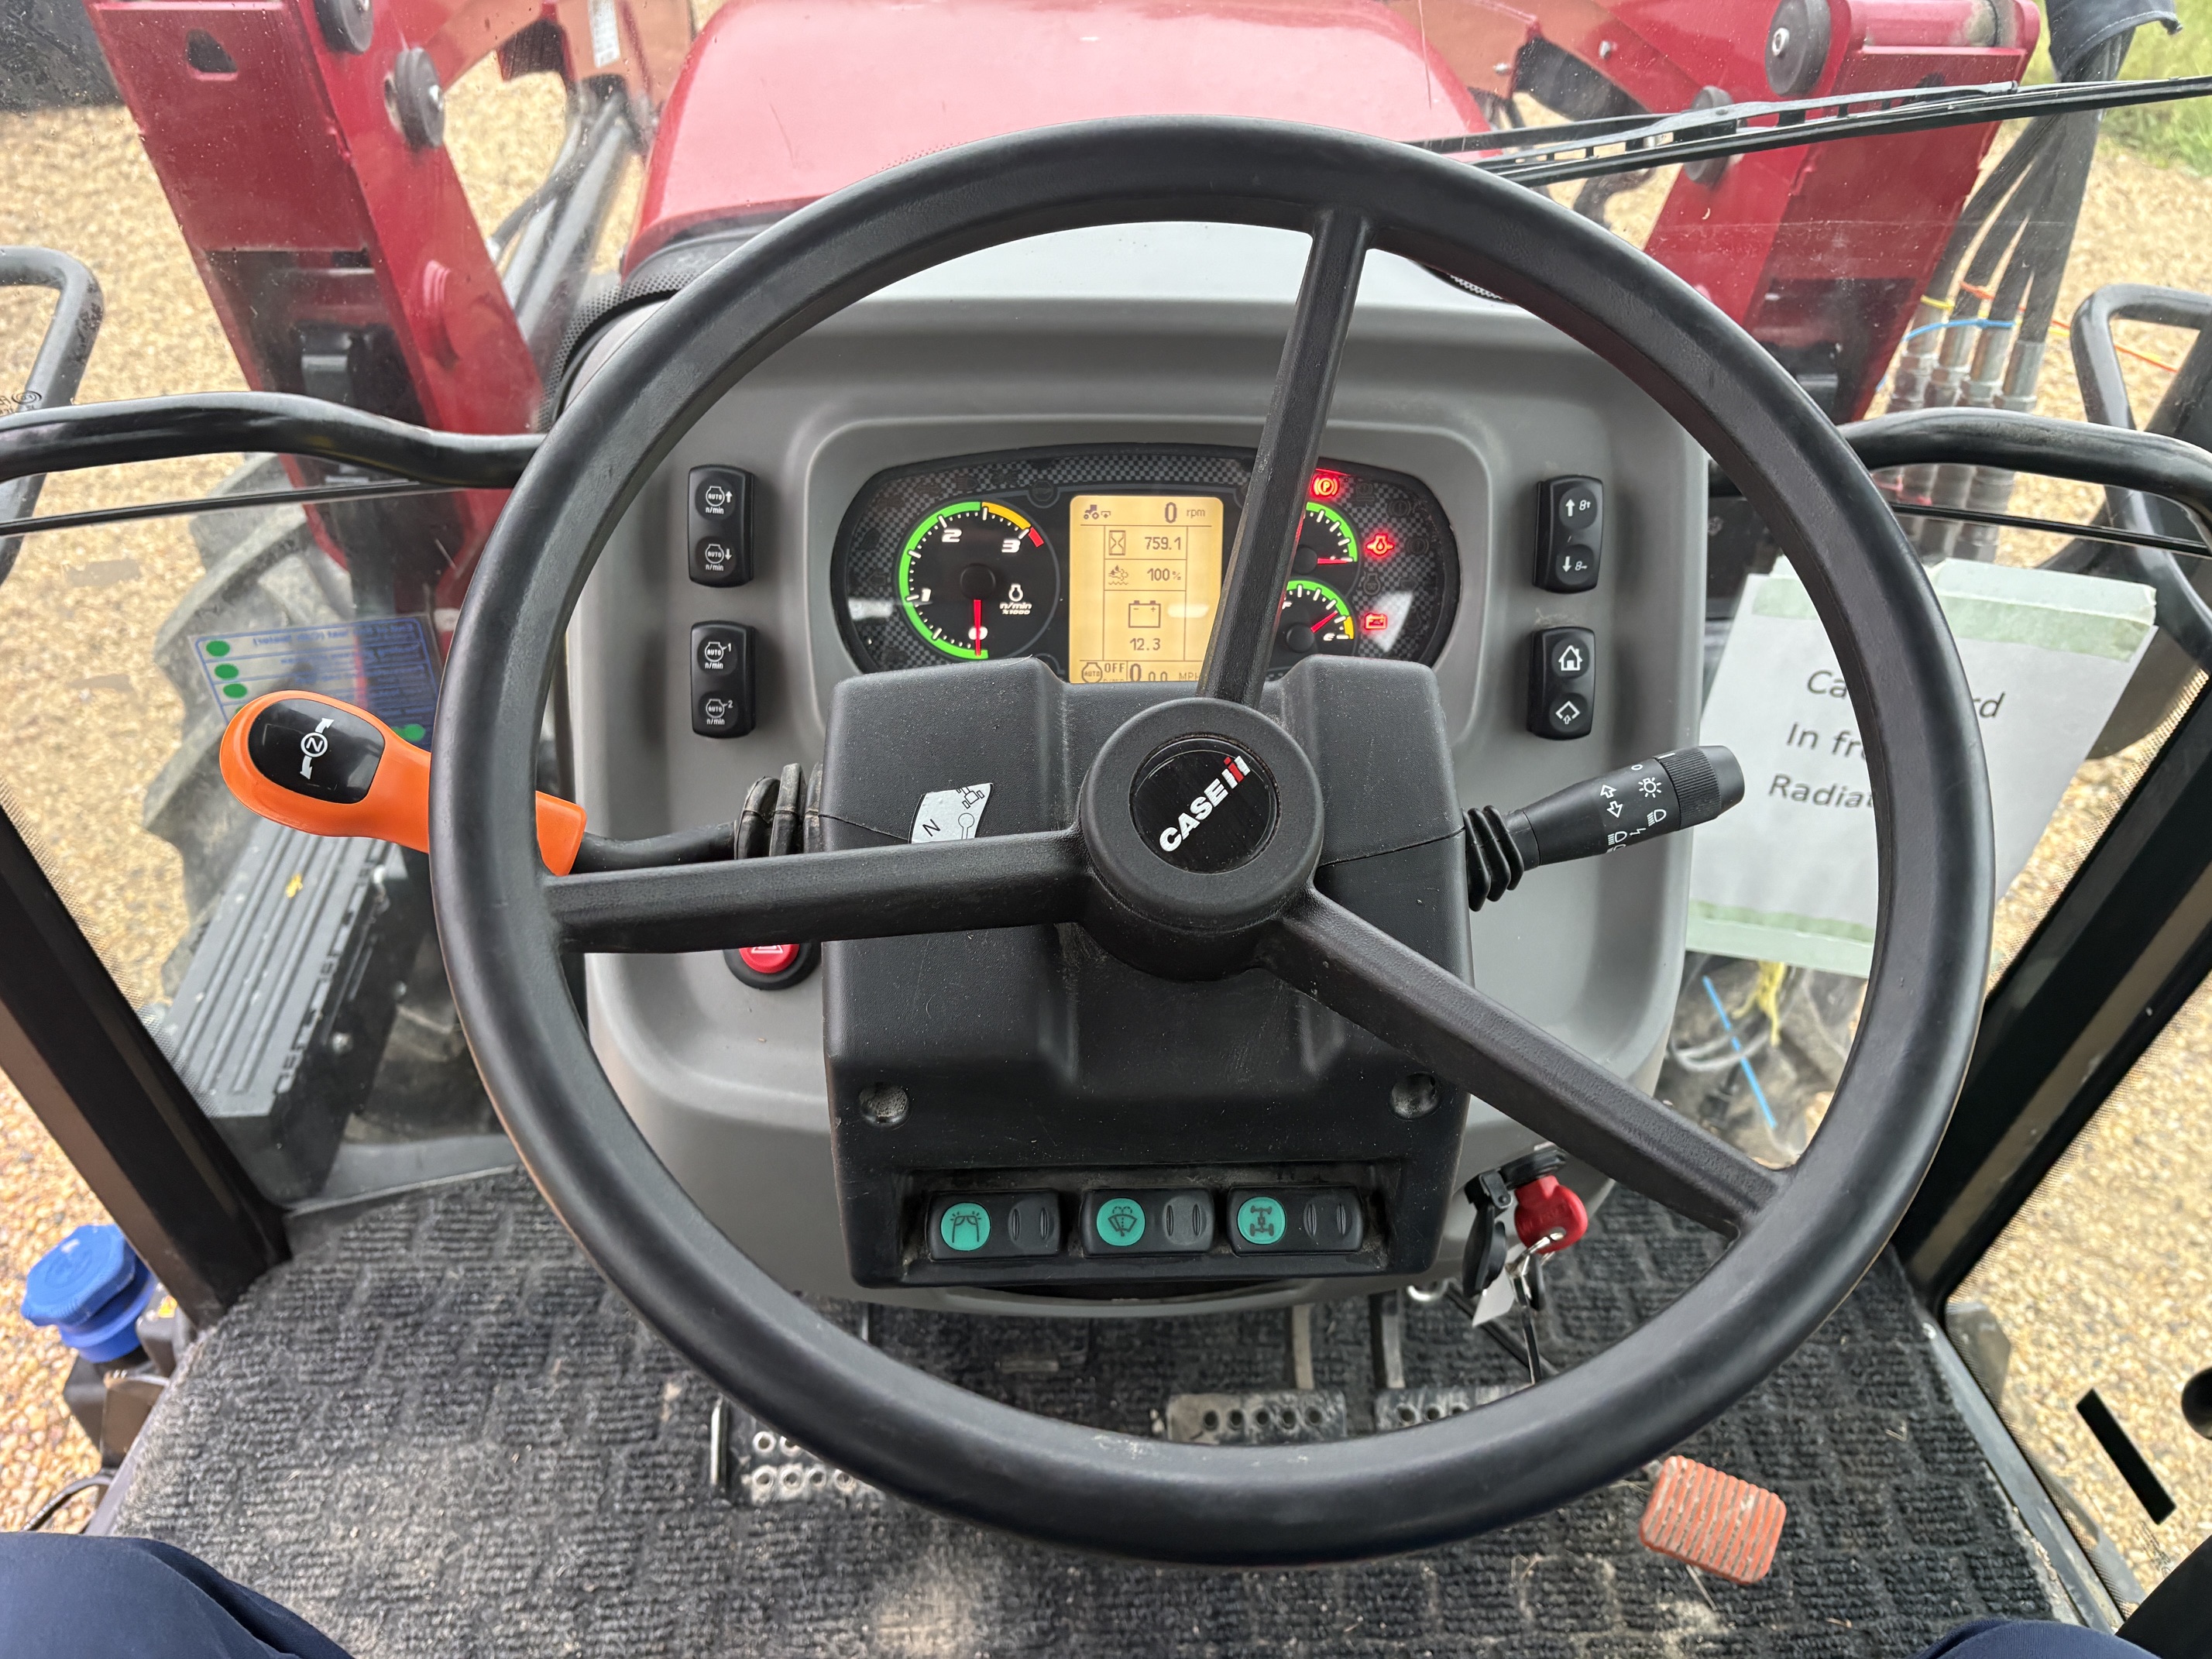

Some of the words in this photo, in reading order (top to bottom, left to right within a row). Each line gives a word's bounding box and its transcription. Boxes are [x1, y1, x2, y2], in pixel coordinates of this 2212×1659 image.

[1165, 502, 1177, 524] 0
[1187, 509, 1206, 517] rpm
[942, 528, 962, 543] 2
[1001, 539, 1021, 553] 3
[1145, 537, 1181, 550] 759.1
[922, 589, 931, 602] 1
[1129, 637, 1161, 651] 12.3
[1104, 663, 1125, 672] OFF
[1129, 663, 1142, 682] 0
[1786, 722, 1819, 750] In
[1159, 778, 1229, 852] CASE
[922, 819, 941, 837] N
